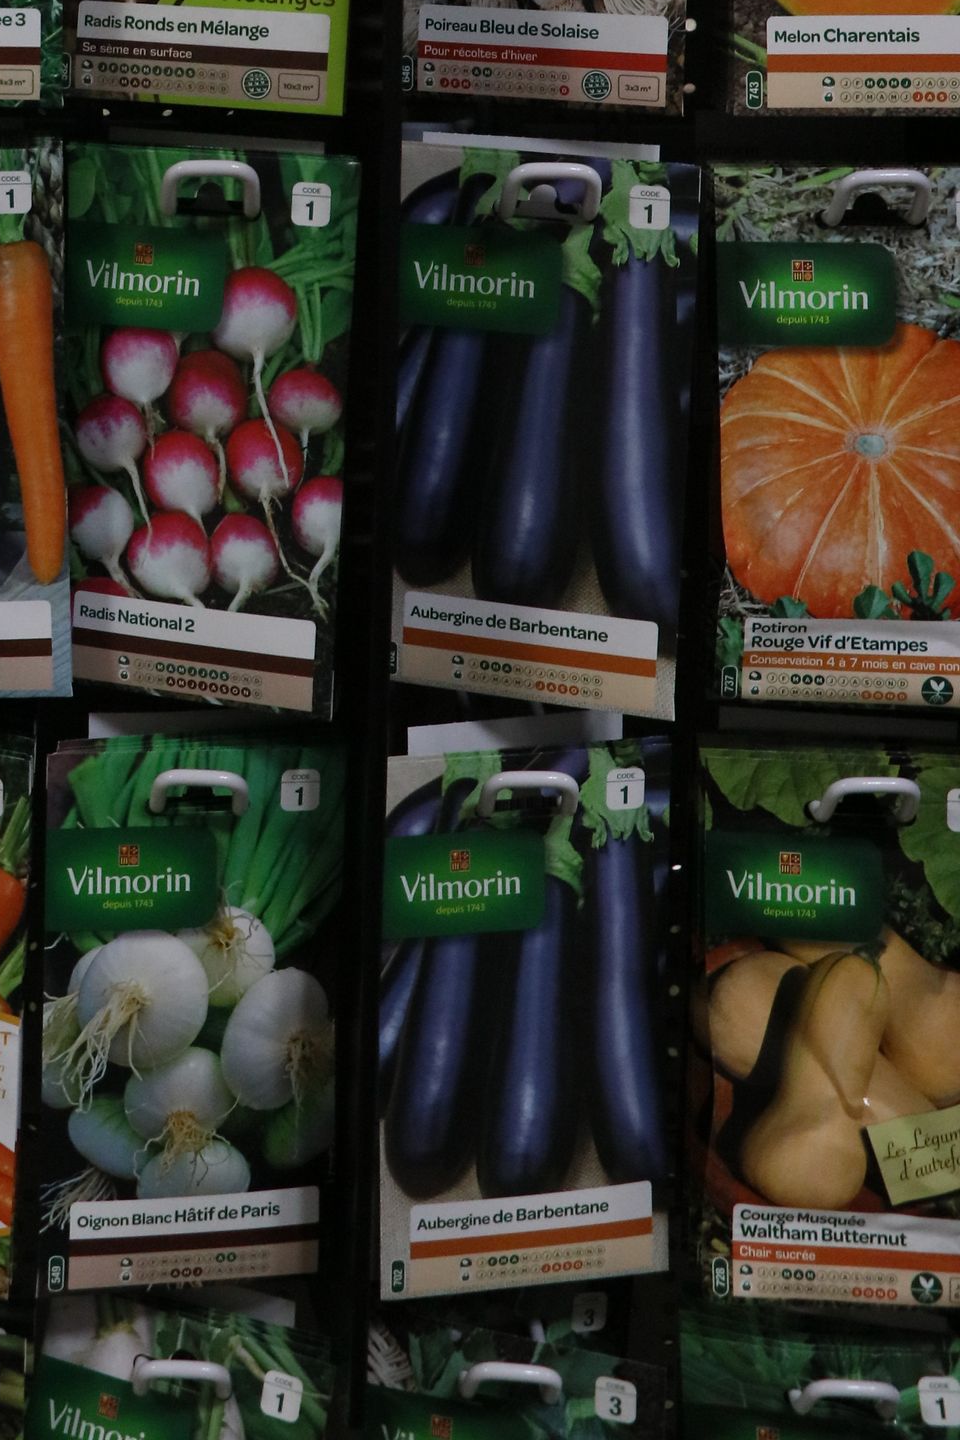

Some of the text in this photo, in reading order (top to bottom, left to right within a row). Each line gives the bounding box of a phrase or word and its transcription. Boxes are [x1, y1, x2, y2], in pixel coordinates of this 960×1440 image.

[16, 14, 25, 26] 3
[84, 15, 269, 40] Radis Ronds en Mélange
[425, 18, 599, 39] Poireau Bleu de Solaise
[775, 28, 920, 42] Melon Charentais
[82, 42, 192, 59] Se sème en surface
[424, 45, 538, 61] Pour récoltes d'hiver
[86, 259, 200, 296] Vilmorin
[413, 260, 534, 299] Vilmorin
[739, 279, 868, 310] Vilmorin
[777, 316, 829, 325] depuis 1743
[80, 605, 195, 632] Radis National 2
[411, 605, 608, 642] Aubergine de Barbentane
[752, 622, 806, 633] Potiron
[752, 635, 927, 654] Rouge Vif d'Etampes
[749, 655, 823, 666] Conservation
[827, 657, 835, 666] 4
[839, 657, 846, 667] à
[850, 658, 858, 668] 7
[862, 660, 888, 669] mois
[910, 662, 935, 670] cave
[67, 866, 190, 895] Vilmorin
[401, 870, 520, 902] Vilmorin
[727, 869, 856, 906] Vilmorin
[78, 1202, 280, 1230] Oignon Blanc Hâtif de Paris
[418, 1201, 609, 1230] Aubergine de Barbentane
[741, 1209, 865, 1226] Courge Musquée
[741, 1224, 906, 1246] Waltham Butternut
[740, 1245, 815, 1261] Chair sucrée
